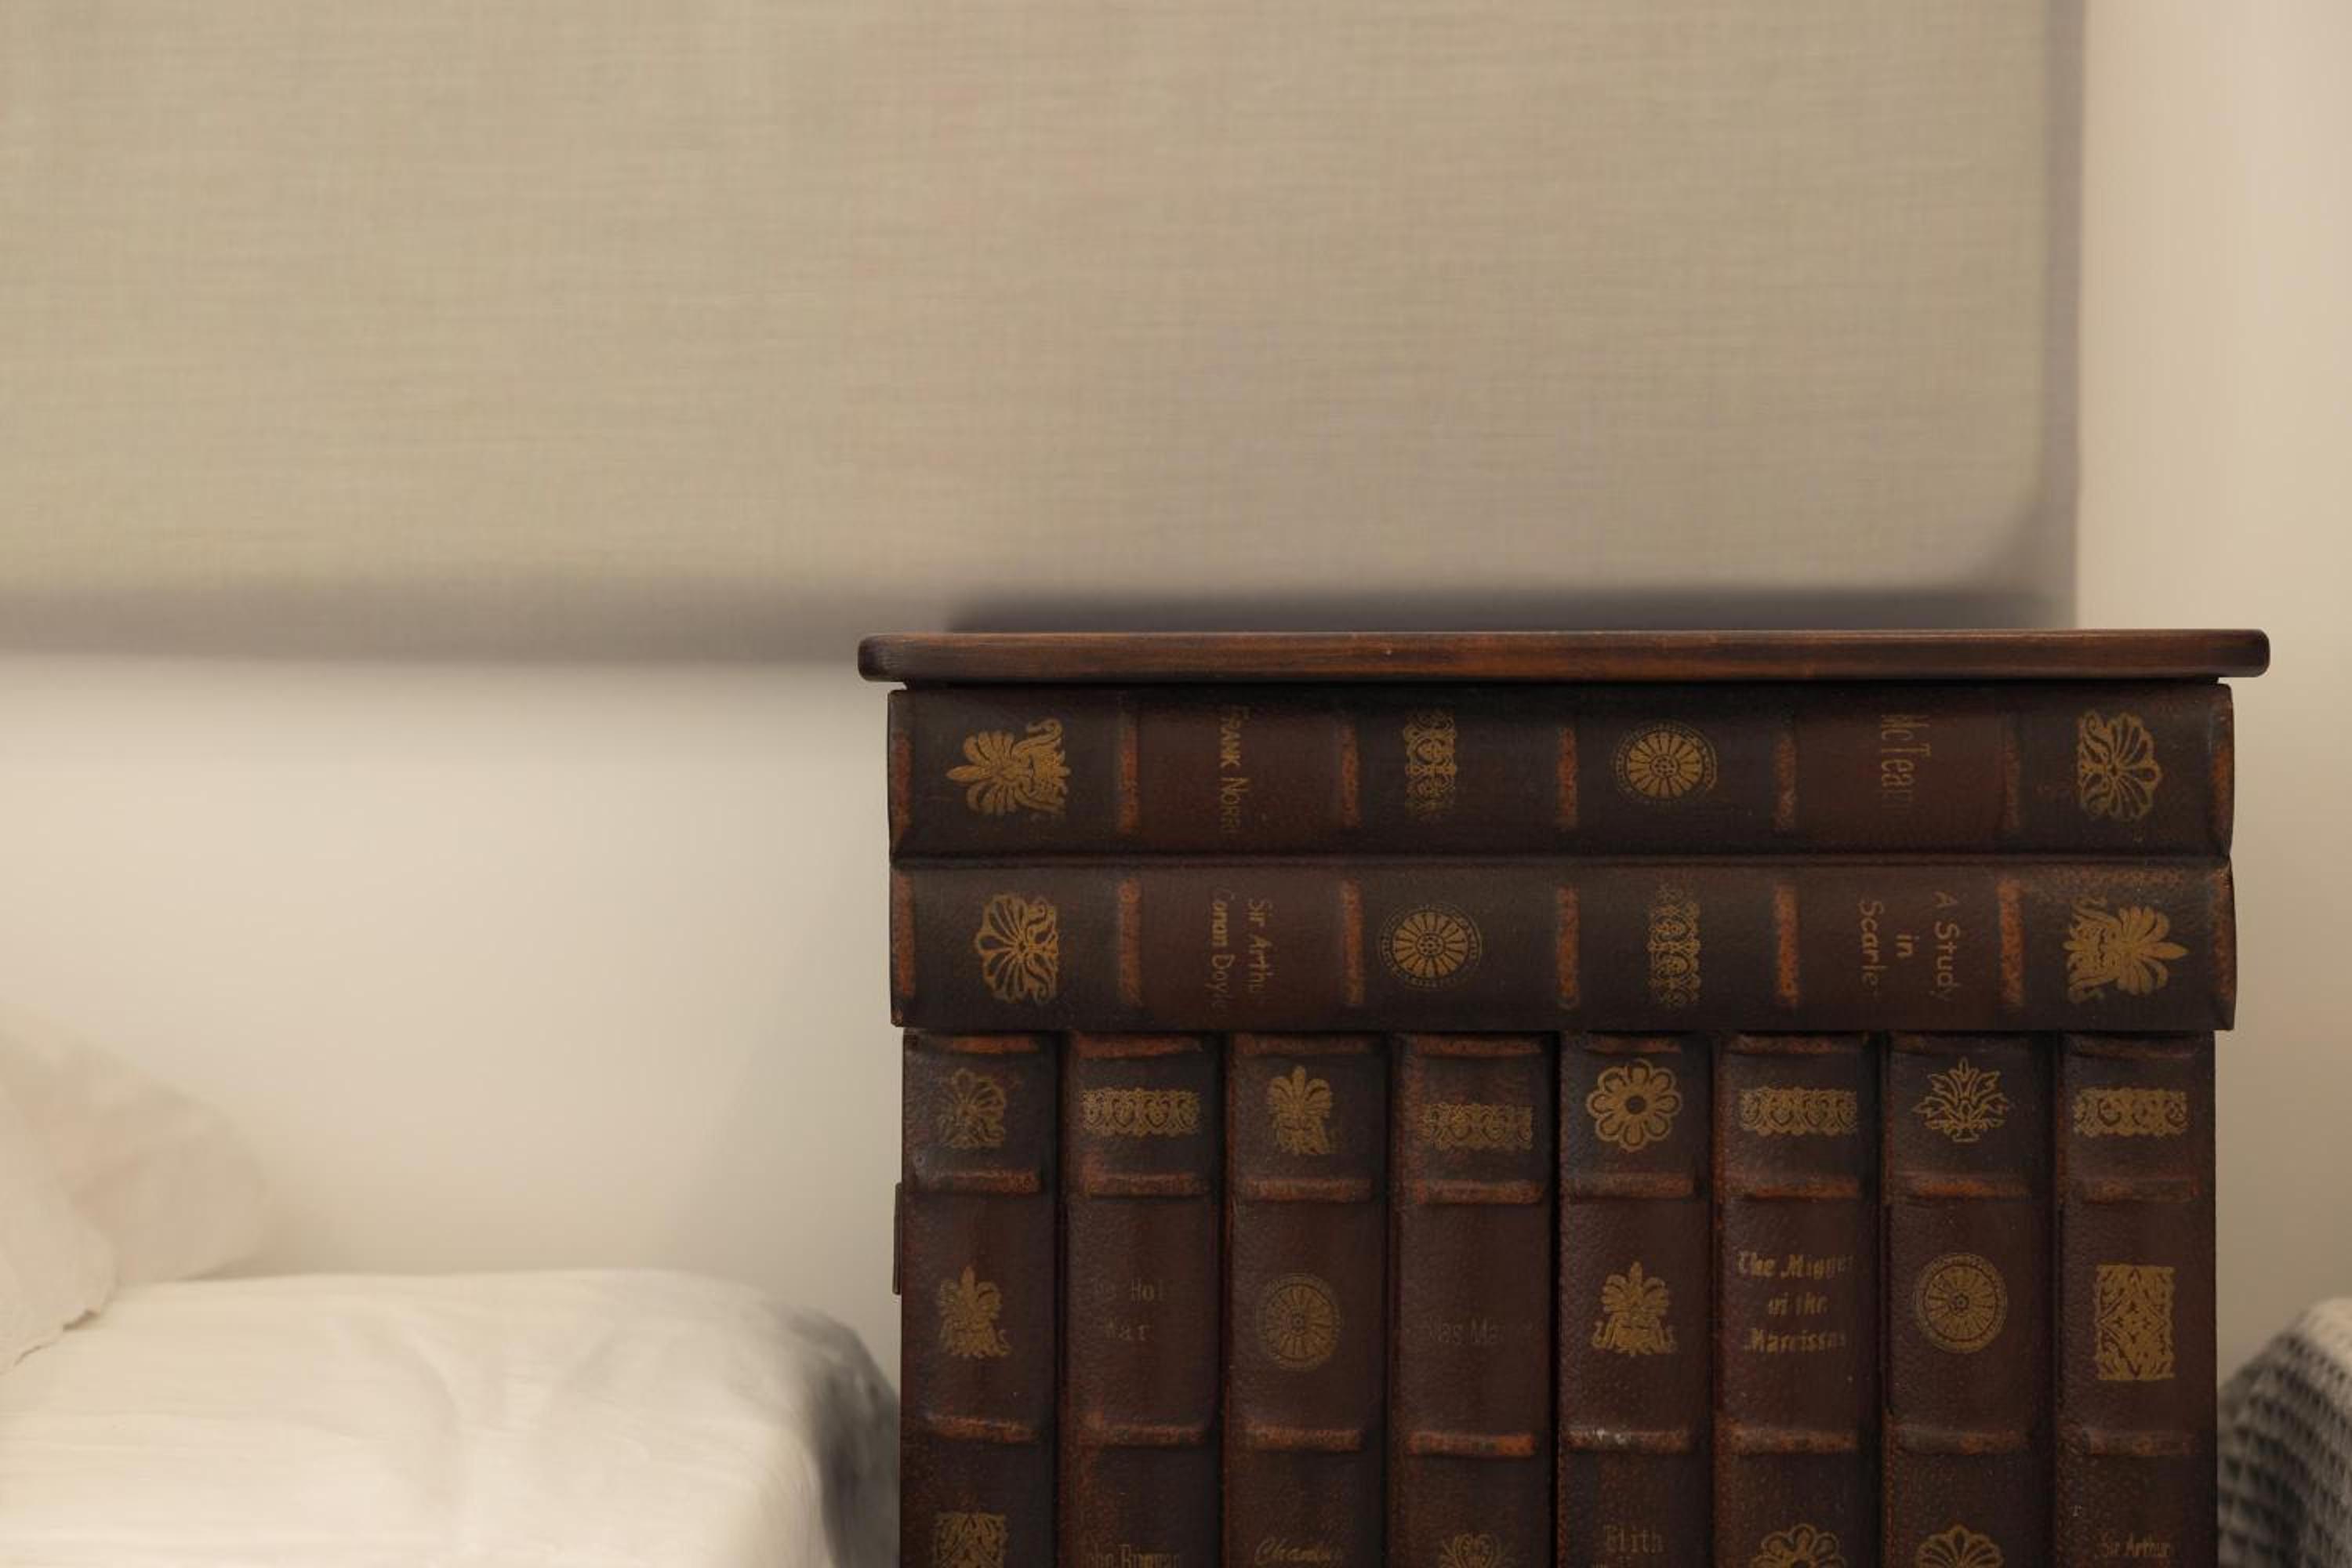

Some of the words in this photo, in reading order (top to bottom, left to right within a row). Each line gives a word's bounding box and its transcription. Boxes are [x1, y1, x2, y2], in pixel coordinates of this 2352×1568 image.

[1249, 898, 1273, 927] Sir
[1934, 891, 1958, 909] A
[1895, 934, 1920, 959] in
[1248, 934, 1275, 993] Arthu
[1927, 920, 1962, 1002] Study
[1737, 1251, 1777, 1278] The
